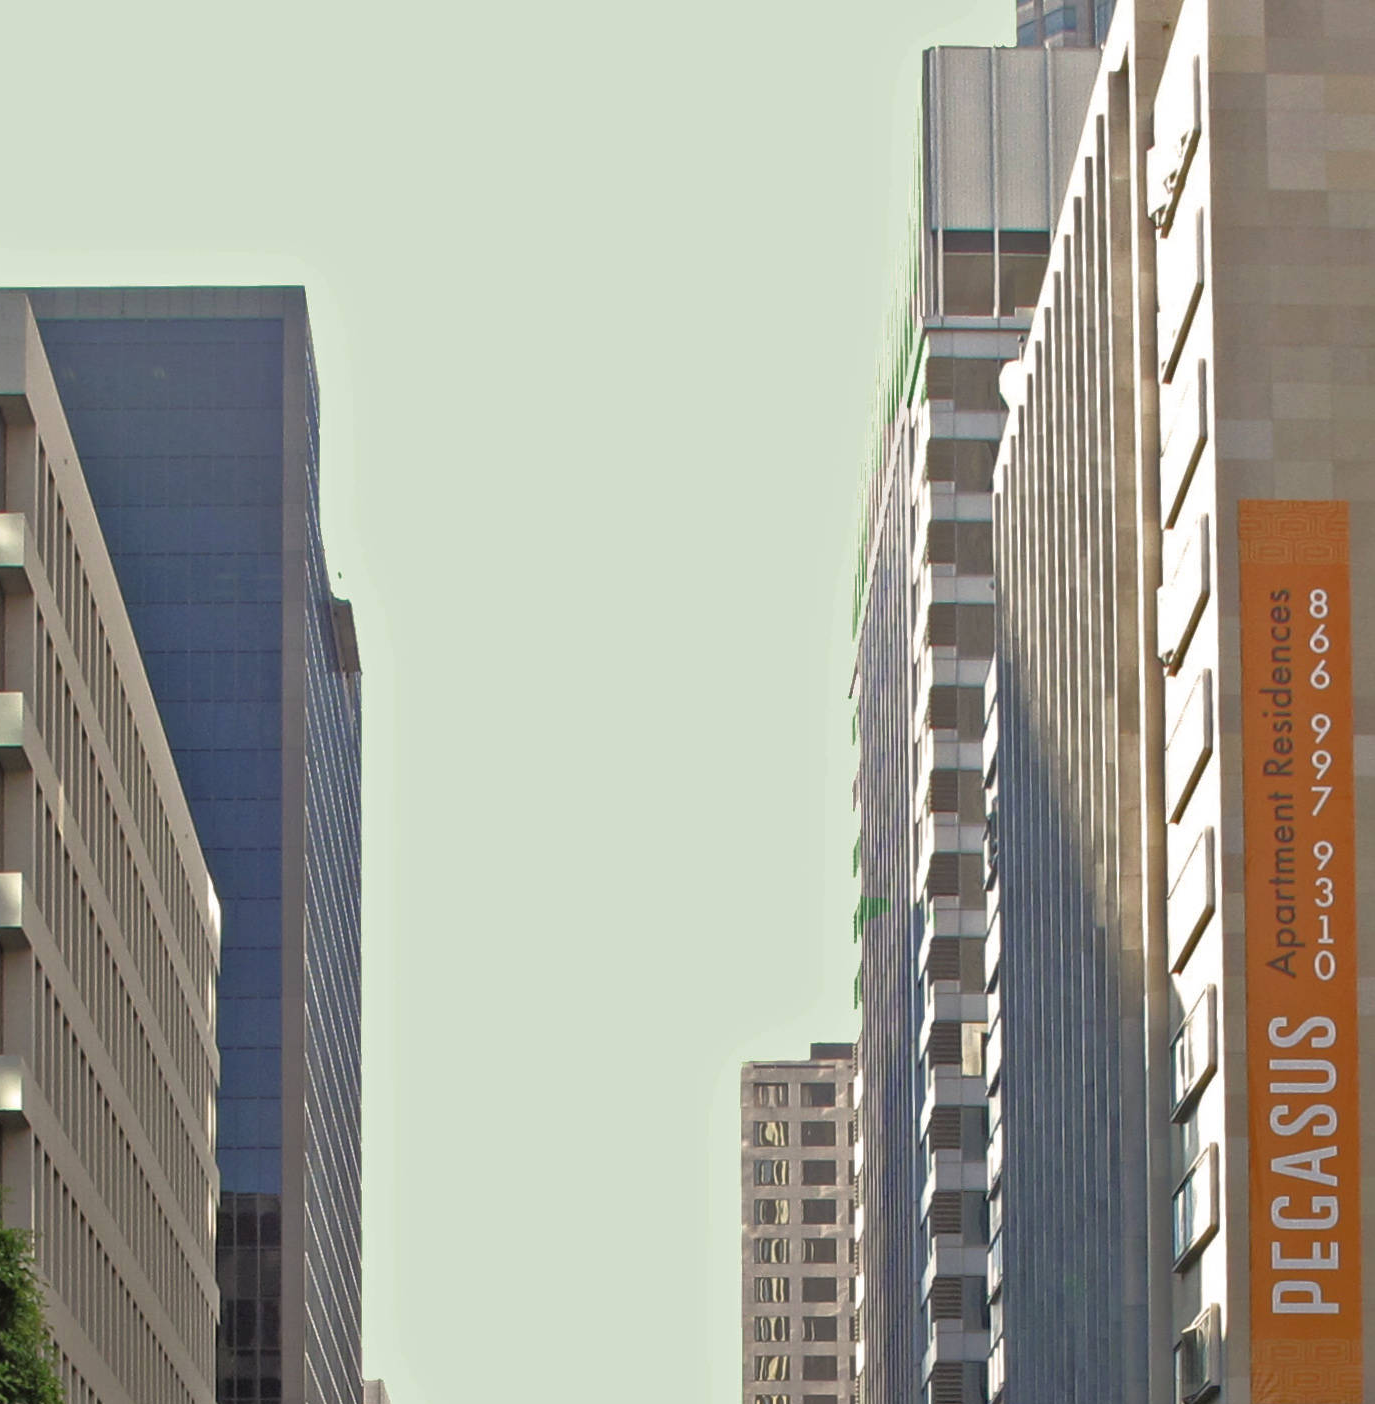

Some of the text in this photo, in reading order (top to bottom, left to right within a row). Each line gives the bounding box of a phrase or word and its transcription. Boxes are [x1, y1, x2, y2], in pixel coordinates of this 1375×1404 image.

[1259, 587, 1305, 979] Apartment Residences
[1308, 587, 1336, 982] 866 997 9310
[1267, 1015, 1340, 1315] PEGASUS
